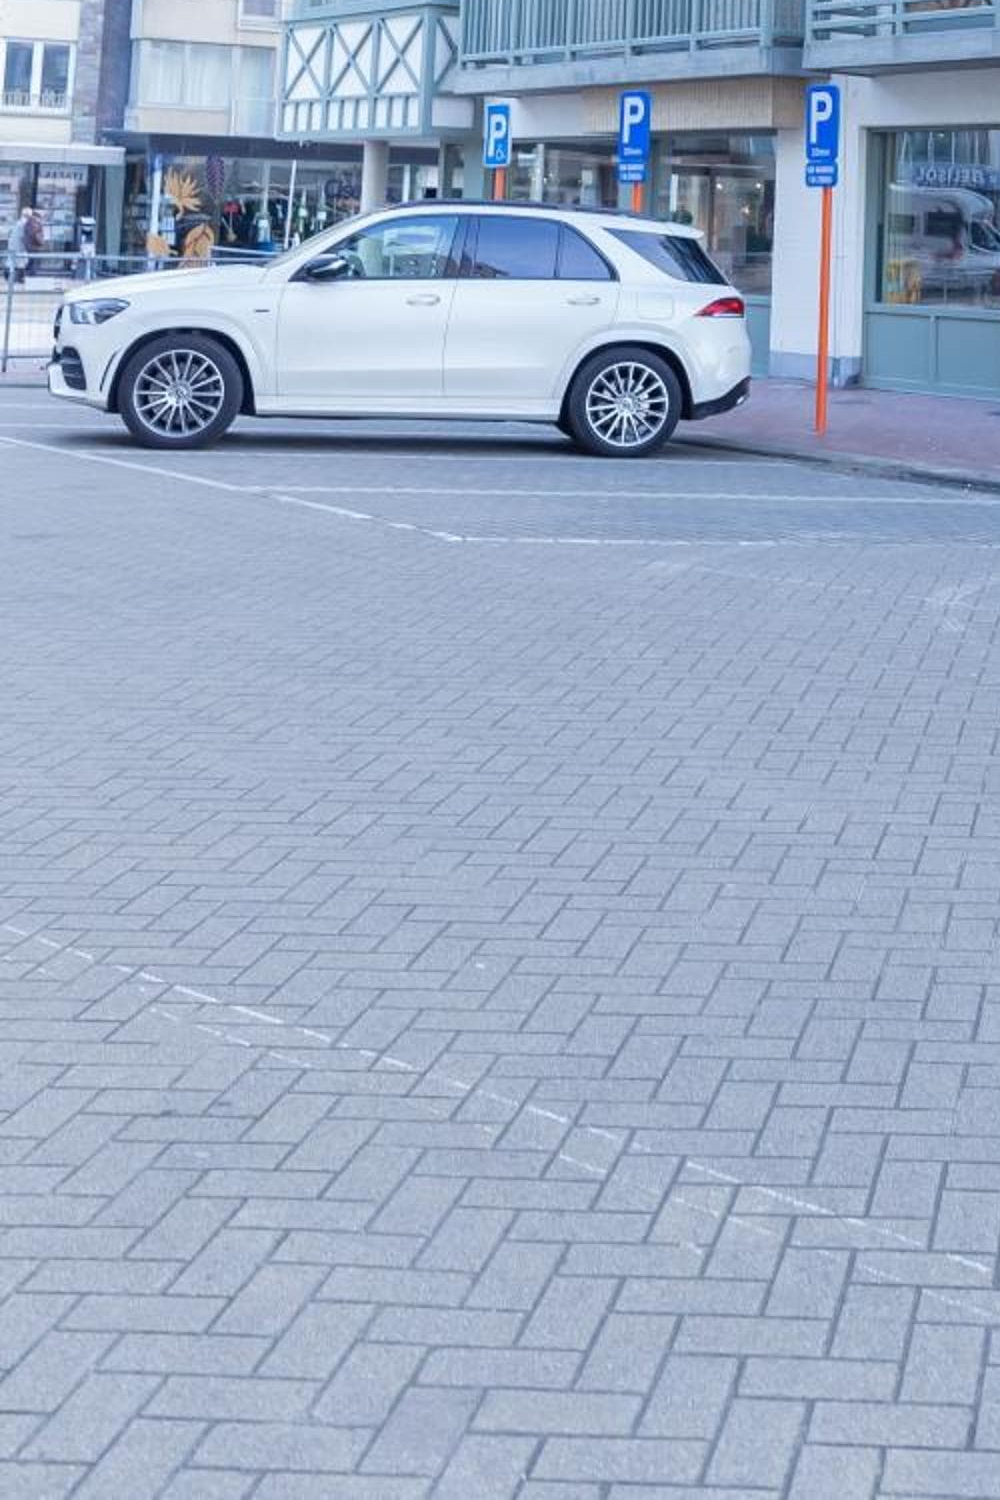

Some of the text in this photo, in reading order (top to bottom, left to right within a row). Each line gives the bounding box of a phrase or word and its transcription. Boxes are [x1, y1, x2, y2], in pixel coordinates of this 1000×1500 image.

[488, 114, 507, 157] P
[622, 96, 645, 143] P
[810, 92, 833, 143] P
